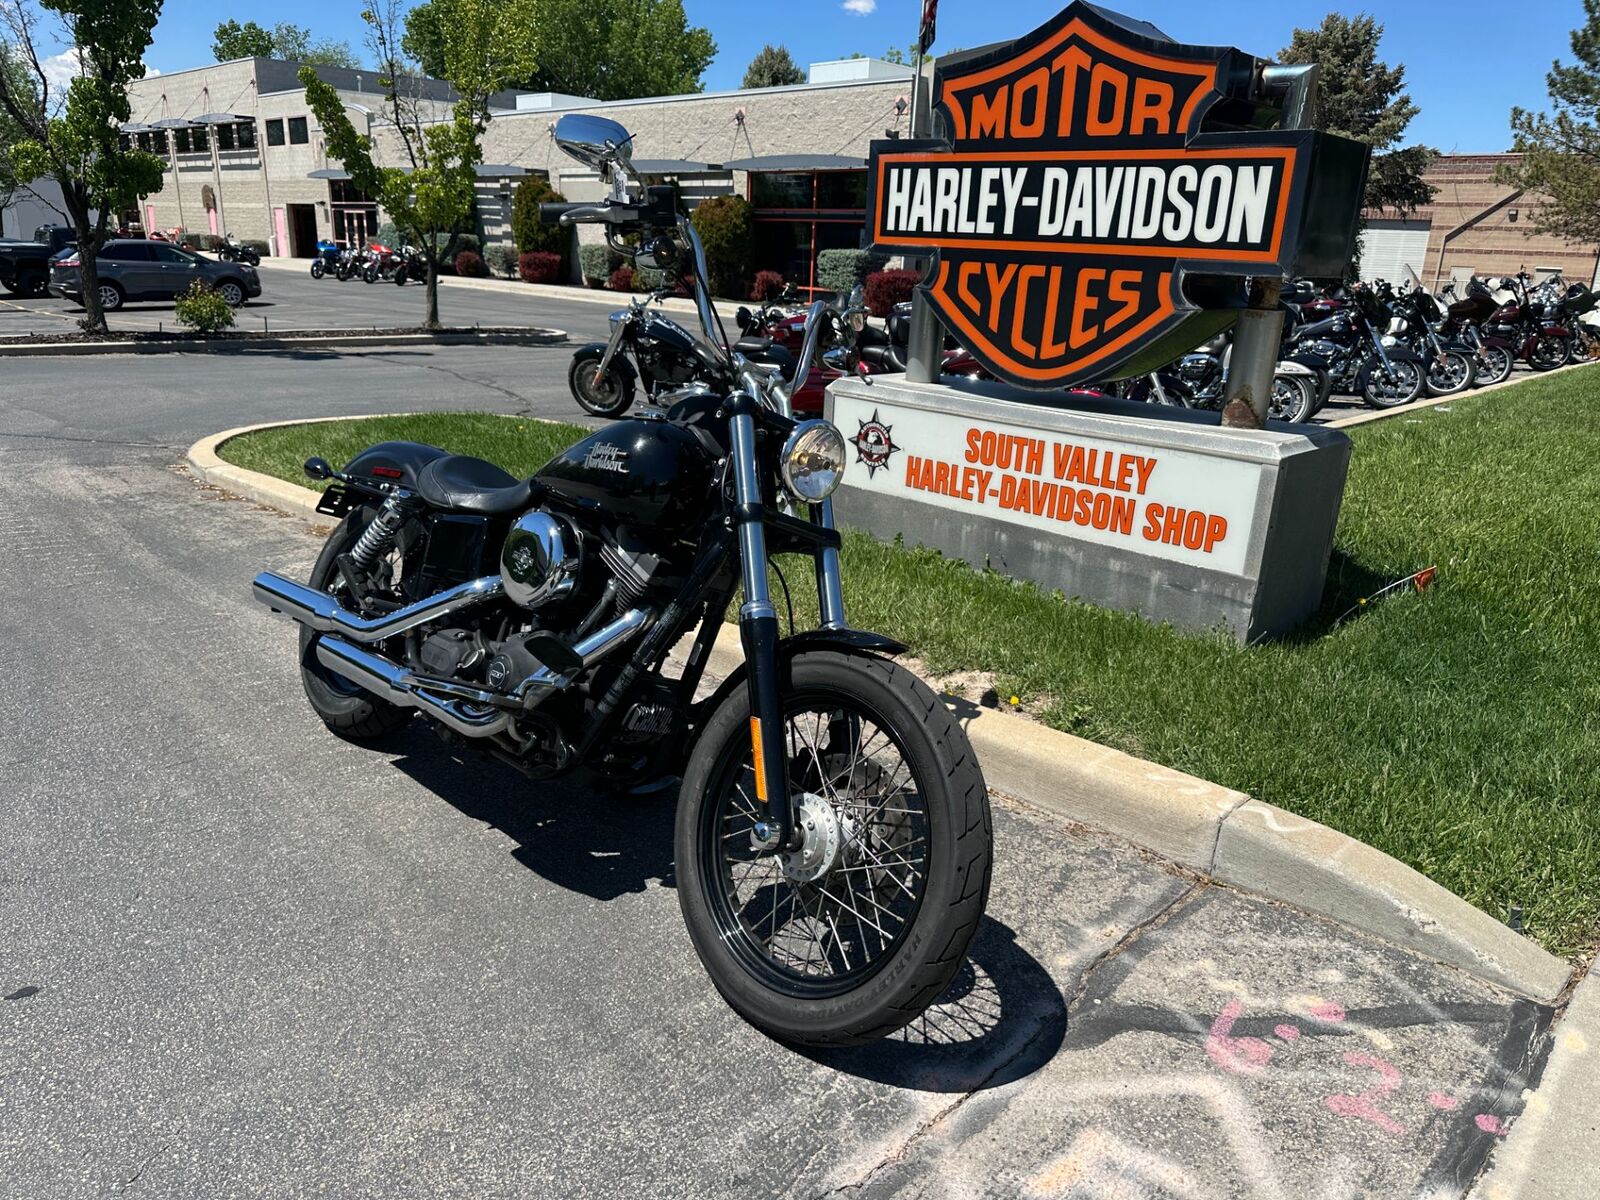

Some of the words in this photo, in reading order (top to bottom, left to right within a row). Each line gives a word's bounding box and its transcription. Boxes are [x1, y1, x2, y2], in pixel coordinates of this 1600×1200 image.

[970, 45, 1174, 139] MOTOR
[887, 165, 1273, 244] HARLEY-DAVIDSON
[957, 261, 1142, 360] CYCLES
[905, 456, 1136, 535] HARLEY-DAVIDSON
[1143, 503, 1227, 553] SHOP
[965, 428, 1045, 475] SOUTH
[1053, 444, 1157, 495] VALLEY
